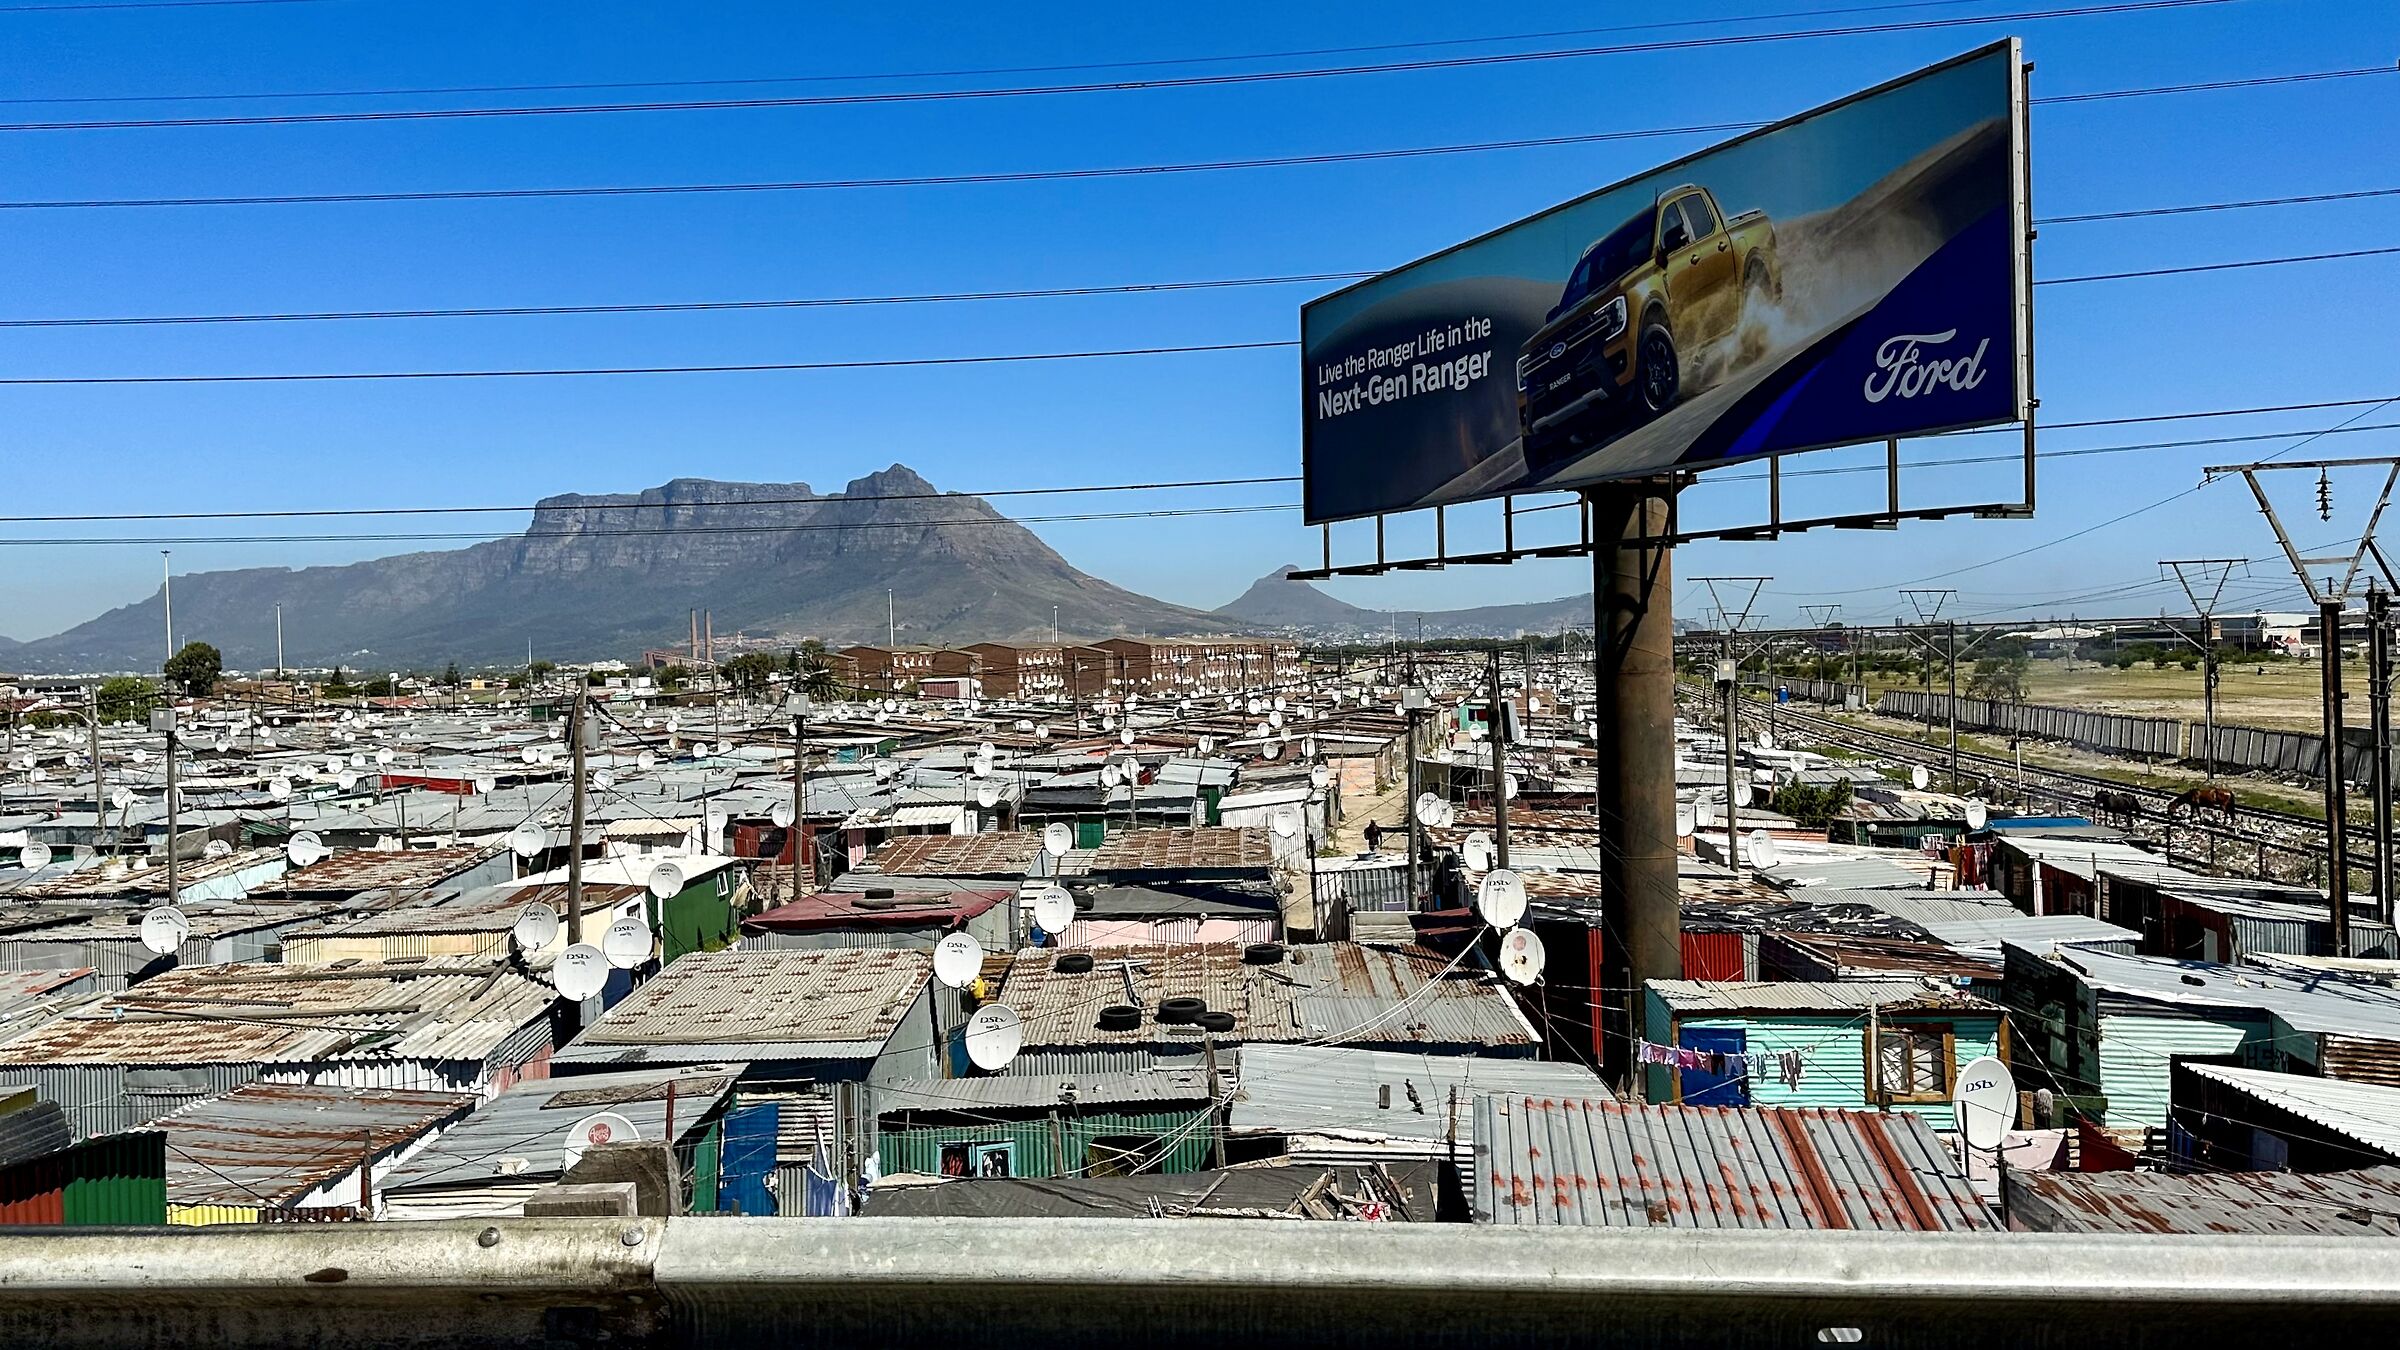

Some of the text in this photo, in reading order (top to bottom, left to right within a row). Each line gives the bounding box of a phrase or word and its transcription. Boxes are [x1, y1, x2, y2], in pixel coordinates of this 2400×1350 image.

[1319, 316, 1492, 386] Live the Ranger Life in the
[1864, 328, 1990, 403] Ford
[1319, 350, 1492, 420] Next-Gen Ranger
[1549, 372, 1571, 390] RANGER
[980, 1016, 1007, 1024] DStv
[1965, 1079, 1998, 1093] DStv
